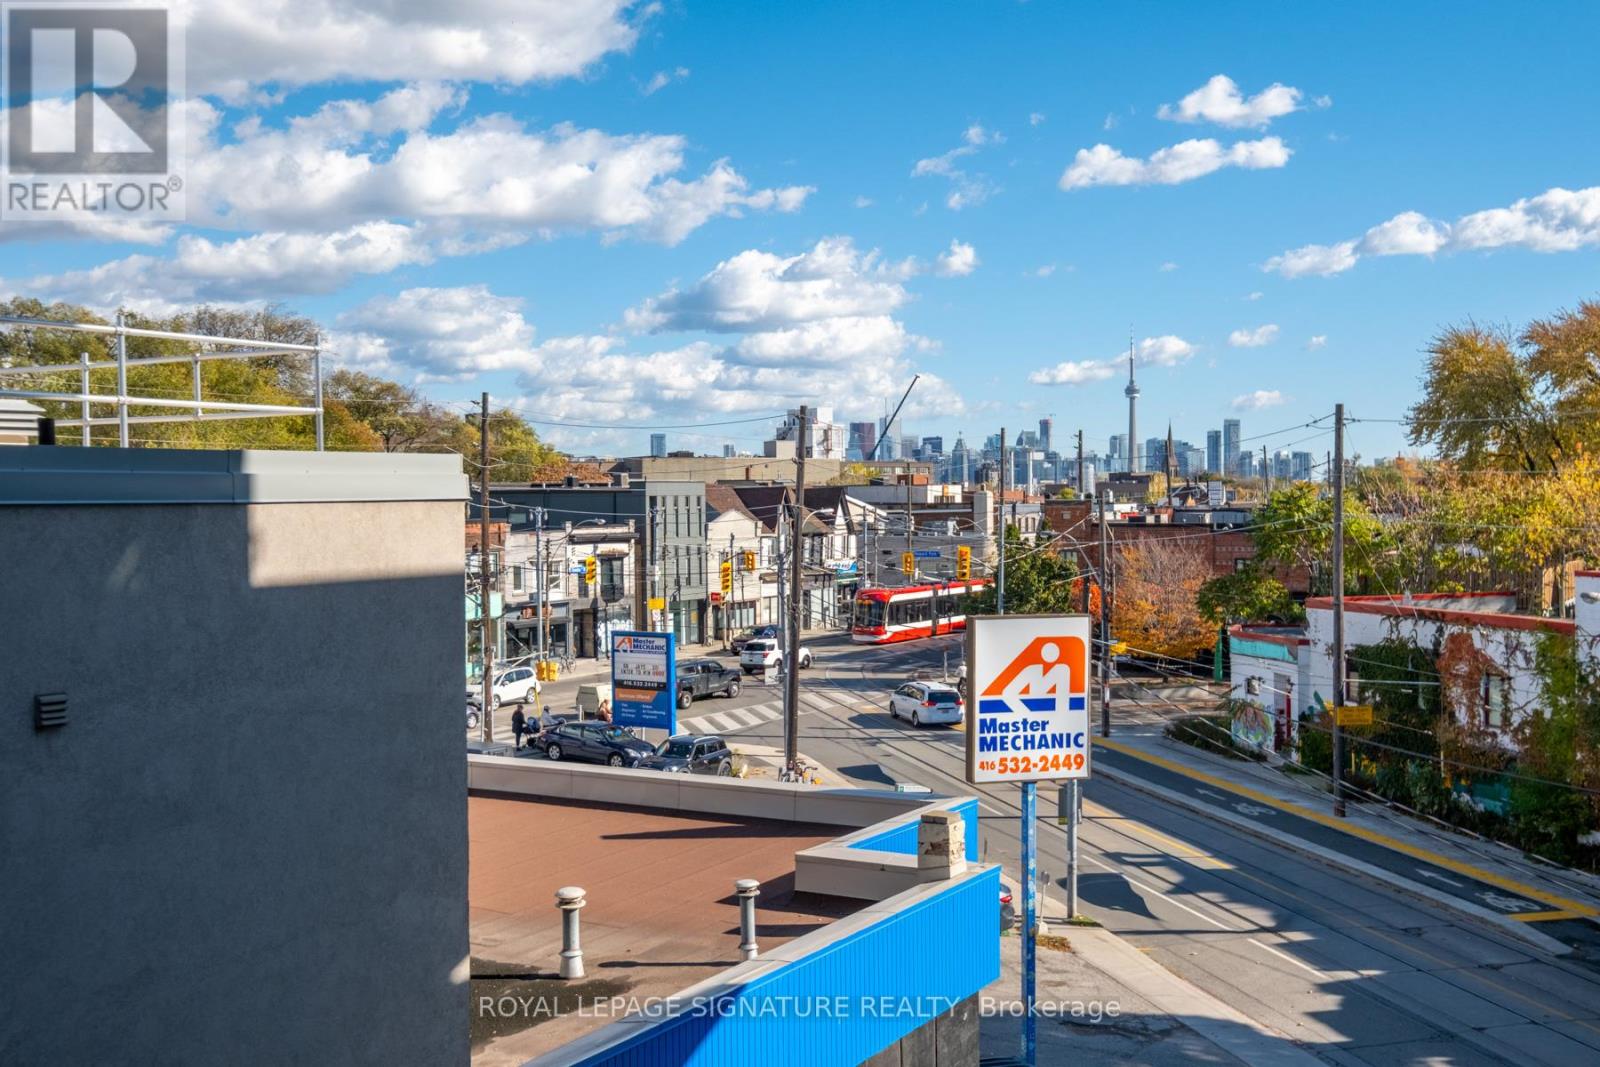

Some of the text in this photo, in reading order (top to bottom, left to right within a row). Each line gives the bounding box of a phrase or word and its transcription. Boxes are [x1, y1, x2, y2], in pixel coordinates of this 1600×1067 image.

[633, 643, 665, 651] MECHANIC
[979, 717, 1050, 735] Master
[979, 732, 1085, 753] MECHANIC
[979, 753, 1085, 774] 416 532-2449
